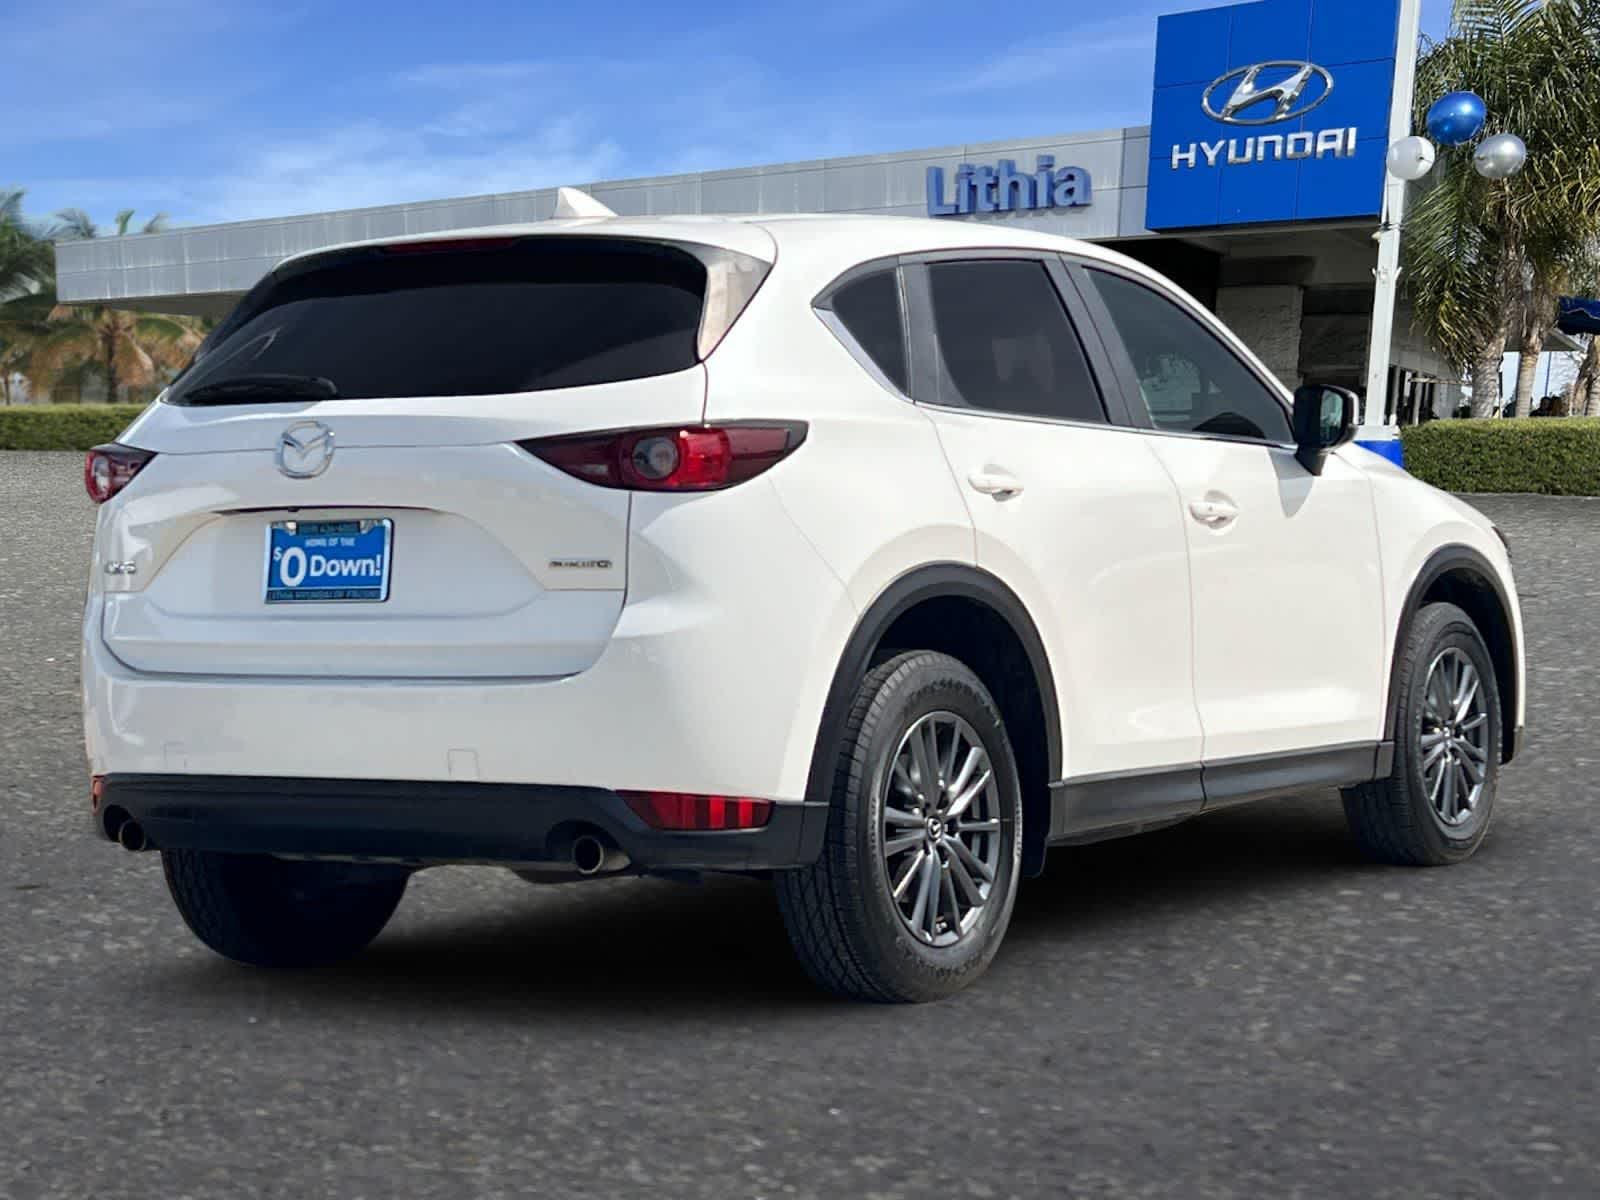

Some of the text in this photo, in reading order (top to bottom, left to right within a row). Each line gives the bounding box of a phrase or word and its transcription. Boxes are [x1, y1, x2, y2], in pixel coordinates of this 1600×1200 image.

[1171, 127, 1358, 169] HYUNDAI
[926, 154, 1093, 217] Lithia
[328, 537, 338, 547] OF
[340, 537, 355, 547] THE
[310, 554, 381, 576] Down!
